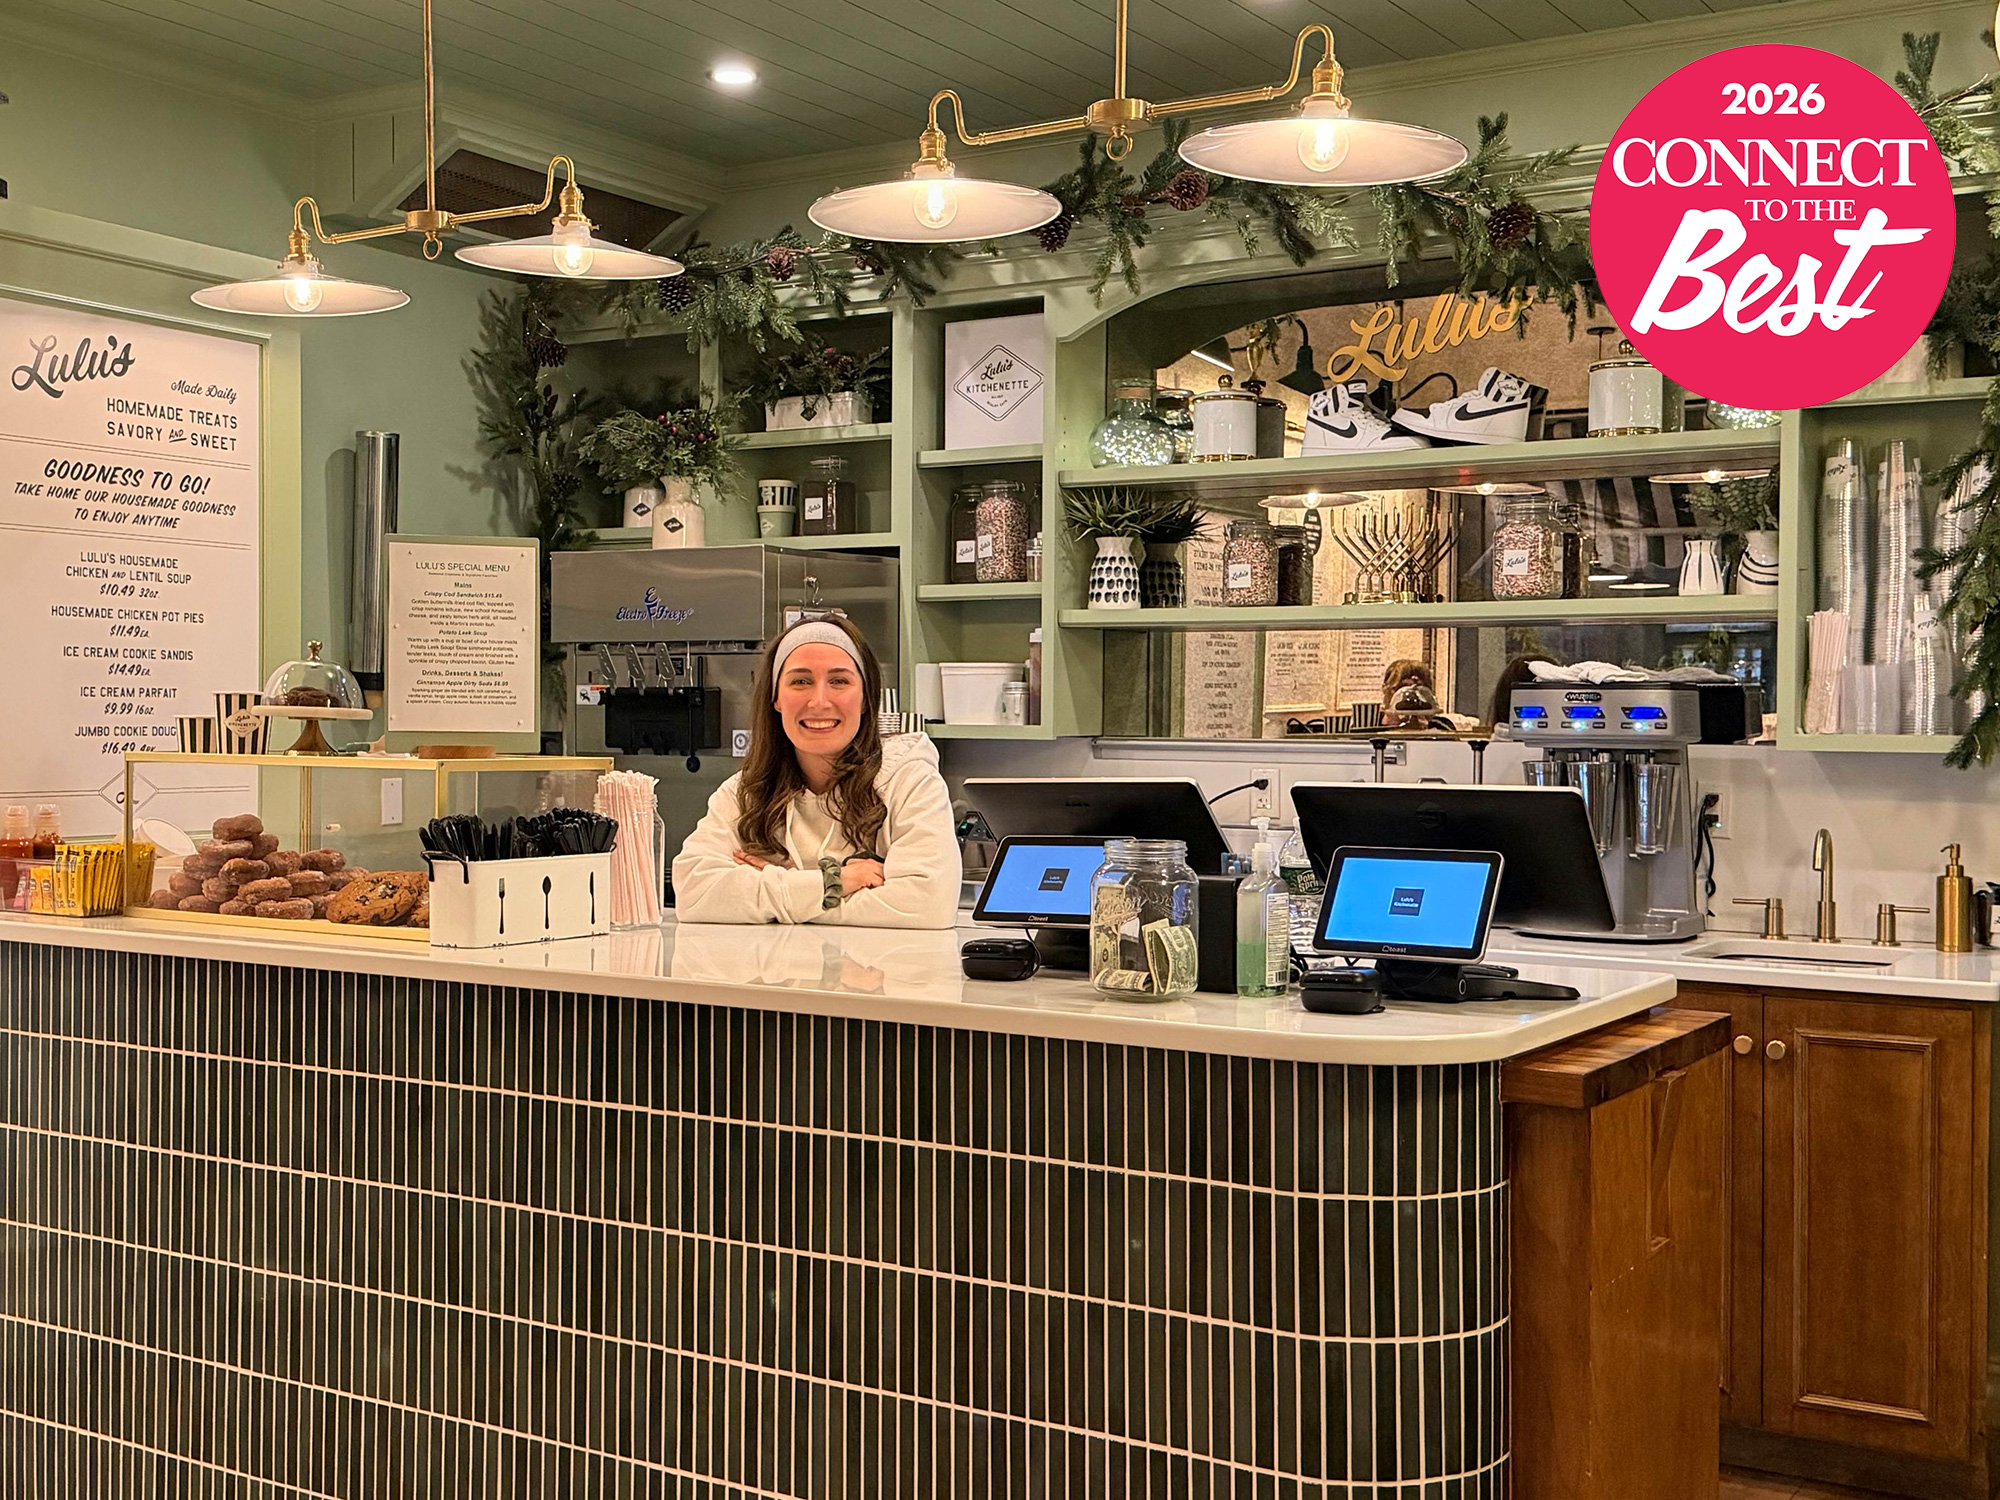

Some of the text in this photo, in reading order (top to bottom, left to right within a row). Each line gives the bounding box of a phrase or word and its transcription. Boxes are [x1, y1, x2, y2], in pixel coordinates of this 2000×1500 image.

[12, 335, 136, 398] Lulu's
[980, 359, 1014, 380] Lulu's
[170, 380, 238, 404] Made Daily
[966, 380, 1028, 394] KITCHENETTE
[107, 398, 238, 429] HOMEMADE TREATS
[107, 422, 236, 451] SAVORY AND SWEET
[44, 458, 211, 495] GOODNESS TO GO!
[14, 482, 236, 516] TAKE HOME OUR HOUSEMADE GOODNESS
[74, 508, 180, 528] TO ENJOY ANYTIME
[80, 552, 178, 569] LULU'S HOUSEMADE
[448, 563, 482, 571] SPECIAL
[485, 564, 510, 572] MENU
[66, 566, 108, 578] CHICKEN
[130, 570, 163, 583] LENTIL
[167, 574, 191, 584] SOUP
[100, 583, 135, 596] $10.49
[51, 605, 204, 624] HOUSEMADE CHICKEN POT PIES
[63, 646, 193, 660] ICE CREAM COOKIE SANDIS
[80, 686, 177, 698] ICE CREAM PARFAIT
[104, 702, 133, 715] $9.99
[75, 726, 176, 736] JUMBO COOKIE DOUG
[102, 742, 135, 754] $16.49
